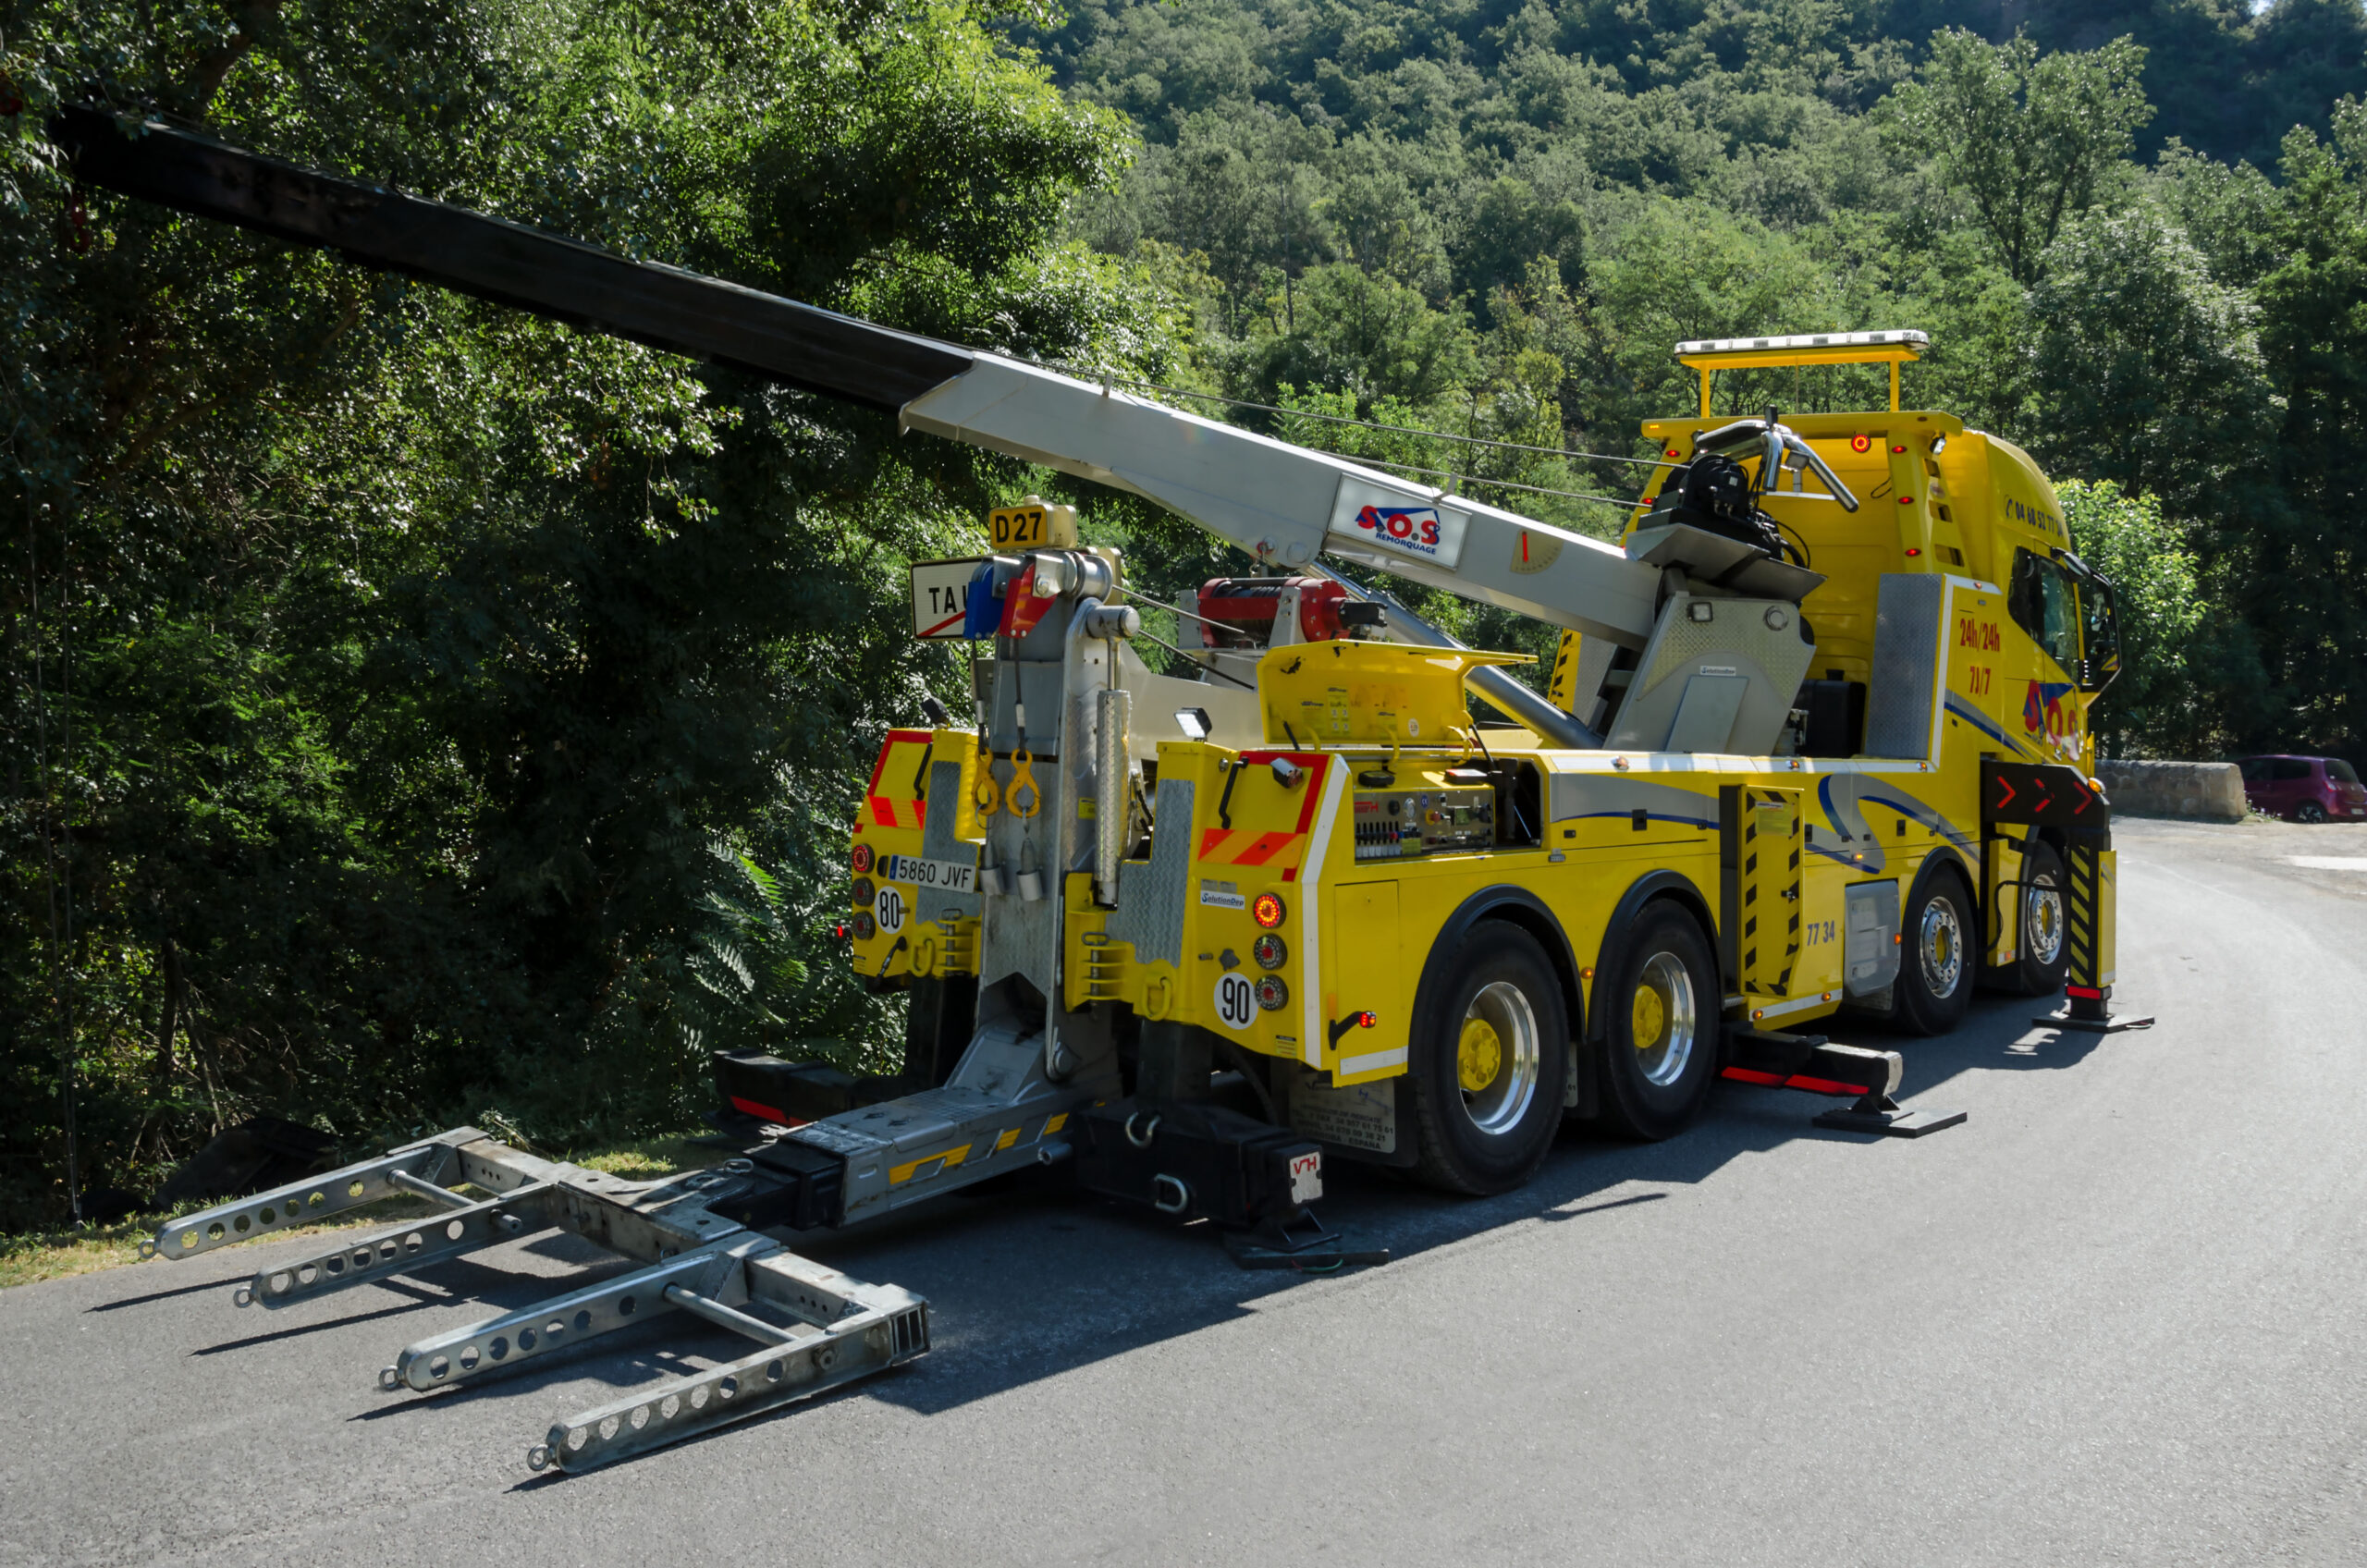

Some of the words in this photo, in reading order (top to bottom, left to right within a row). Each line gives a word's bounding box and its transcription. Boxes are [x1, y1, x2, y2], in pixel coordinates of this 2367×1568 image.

[1376, 533, 1437, 555] REMORQUAGE
[1960, 619, 2000, 652] 24h/24h
[899, 860, 936, 883] 5860
[941, 866, 972, 888] JVF
[879, 891, 900, 929] 80
[1202, 893, 1245, 907] SolutionDep
[1807, 923, 1820, 946] 77
[1823, 920, 1834, 943] 34
[1222, 977, 1249, 1024] 90
